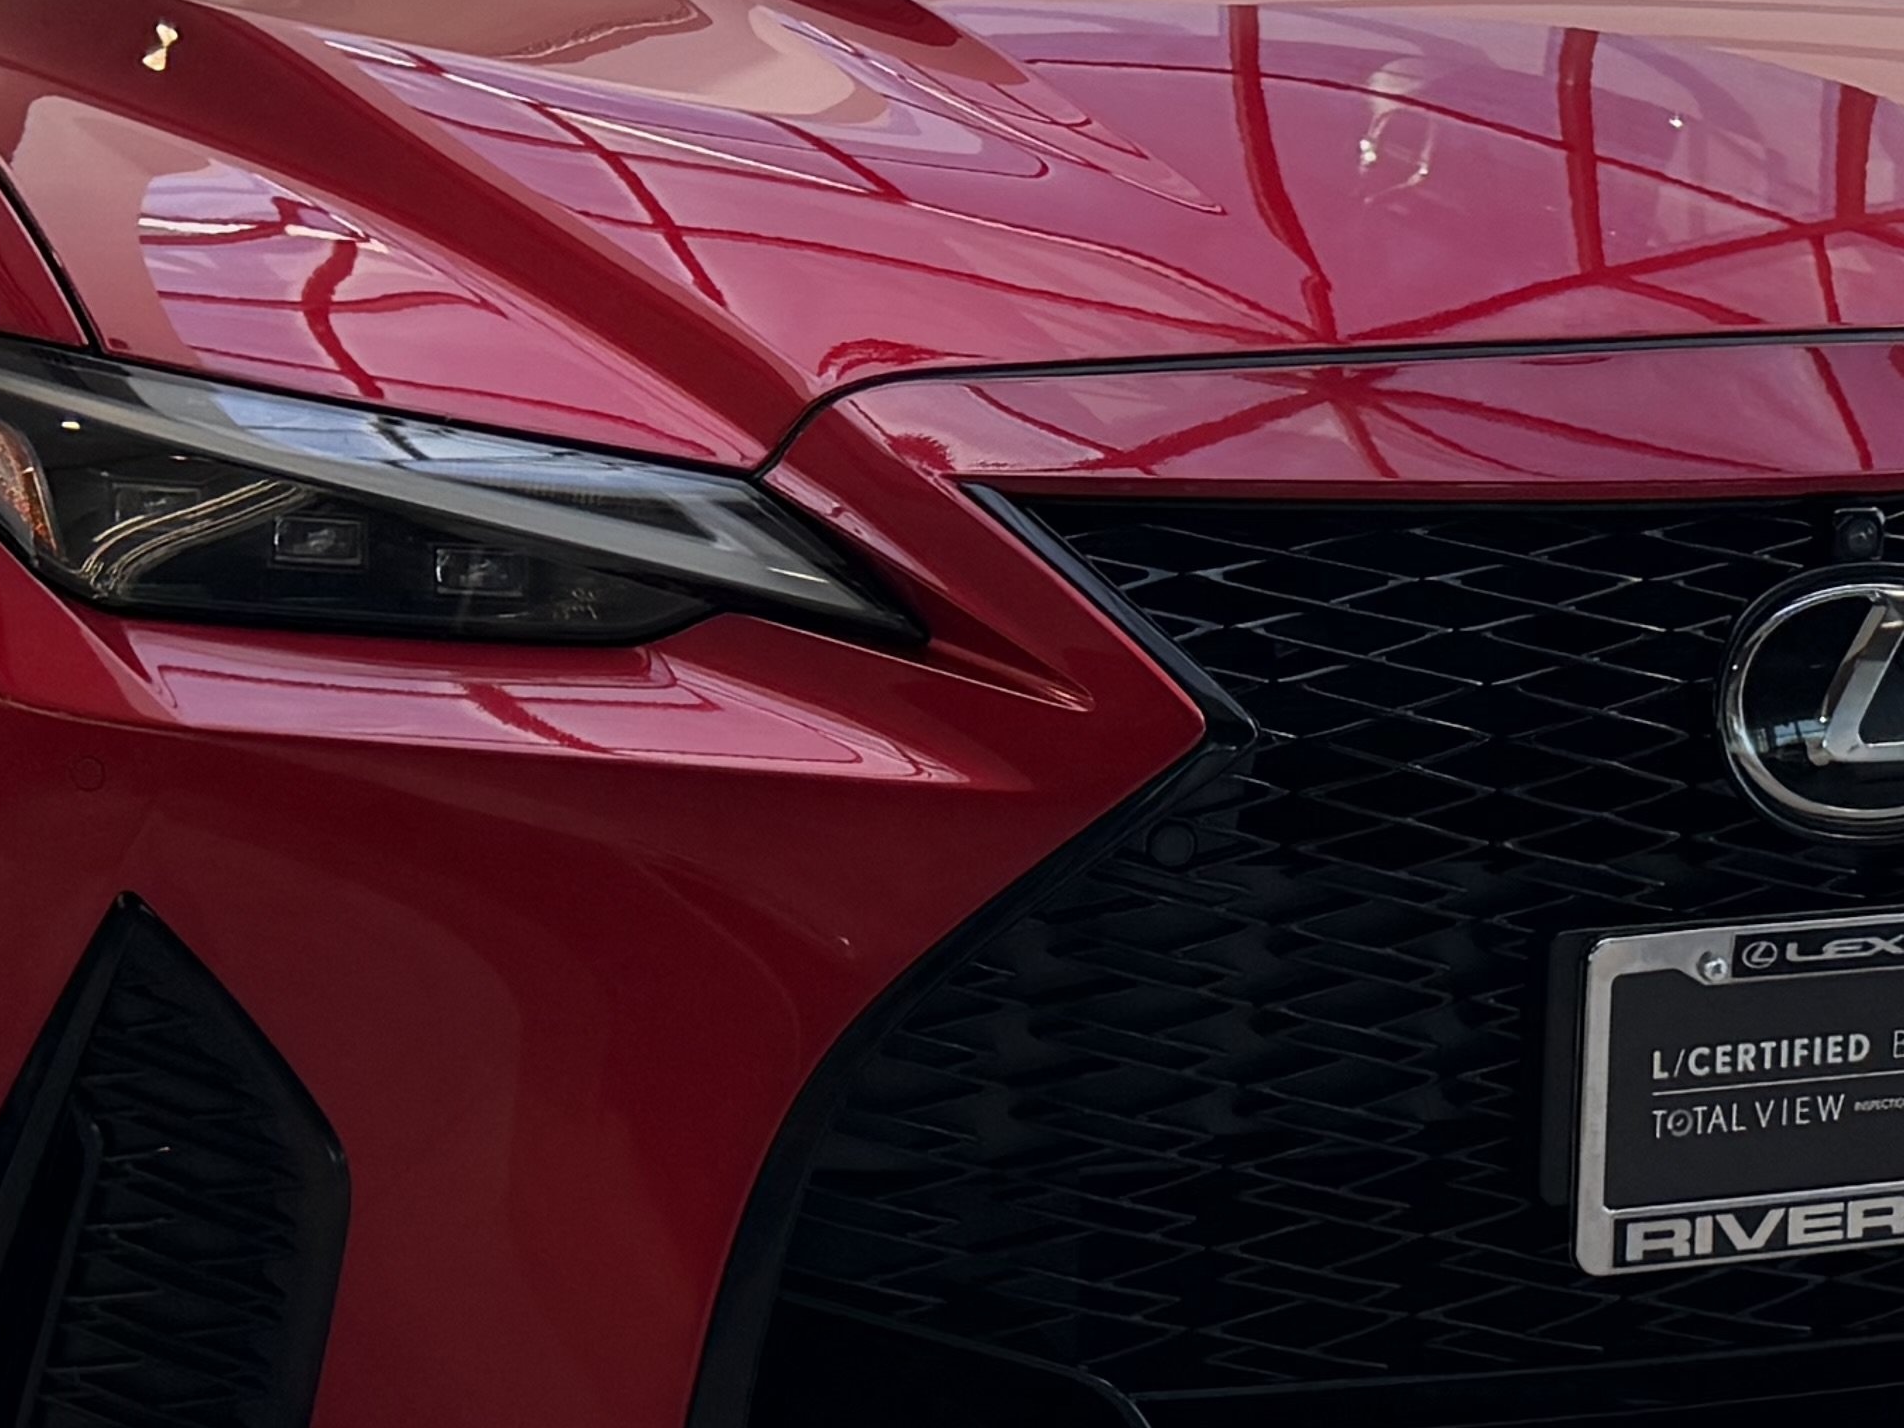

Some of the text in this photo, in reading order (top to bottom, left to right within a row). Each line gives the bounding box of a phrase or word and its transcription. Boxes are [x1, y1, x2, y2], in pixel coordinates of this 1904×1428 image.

[1652, 1033, 1872, 1080] L/CERTIFIED
[1652, 1103, 1747, 1139] TOTAL
[1754, 1093, 1846, 1128] VIEW
